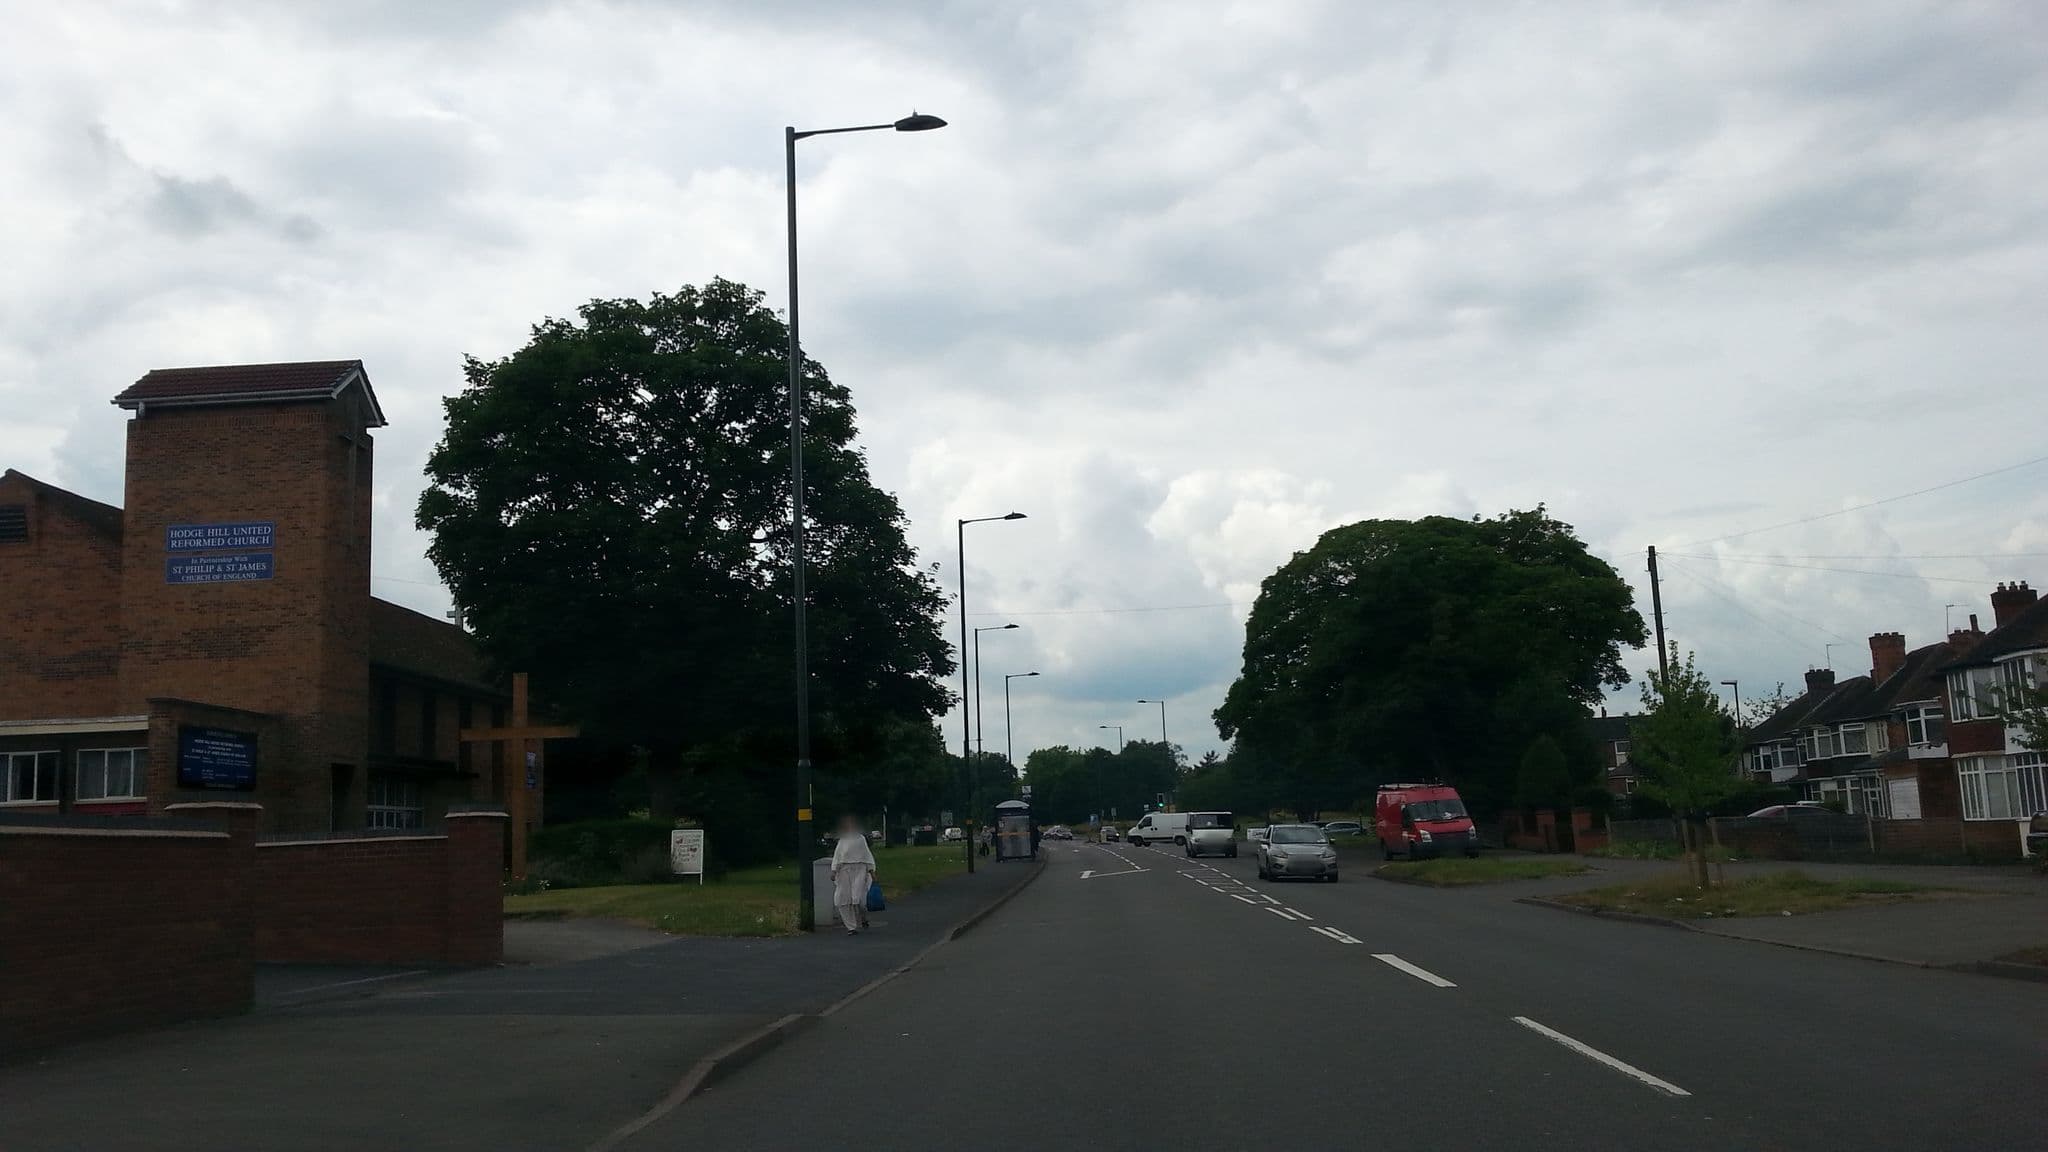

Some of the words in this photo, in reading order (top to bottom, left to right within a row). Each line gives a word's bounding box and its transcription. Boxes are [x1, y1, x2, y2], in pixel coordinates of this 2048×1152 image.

[171, 529, 204, 538] HODGE
[207, 528, 230, 536] HILL
[234, 526, 271, 535] UNITED
[171, 538, 225, 548] REFORMED
[227, 536, 269, 545] CHURCH
[173, 566, 183, 574] ST
[185, 565, 214, 573] PHILIP
[239, 563, 266, 571] JAMES
